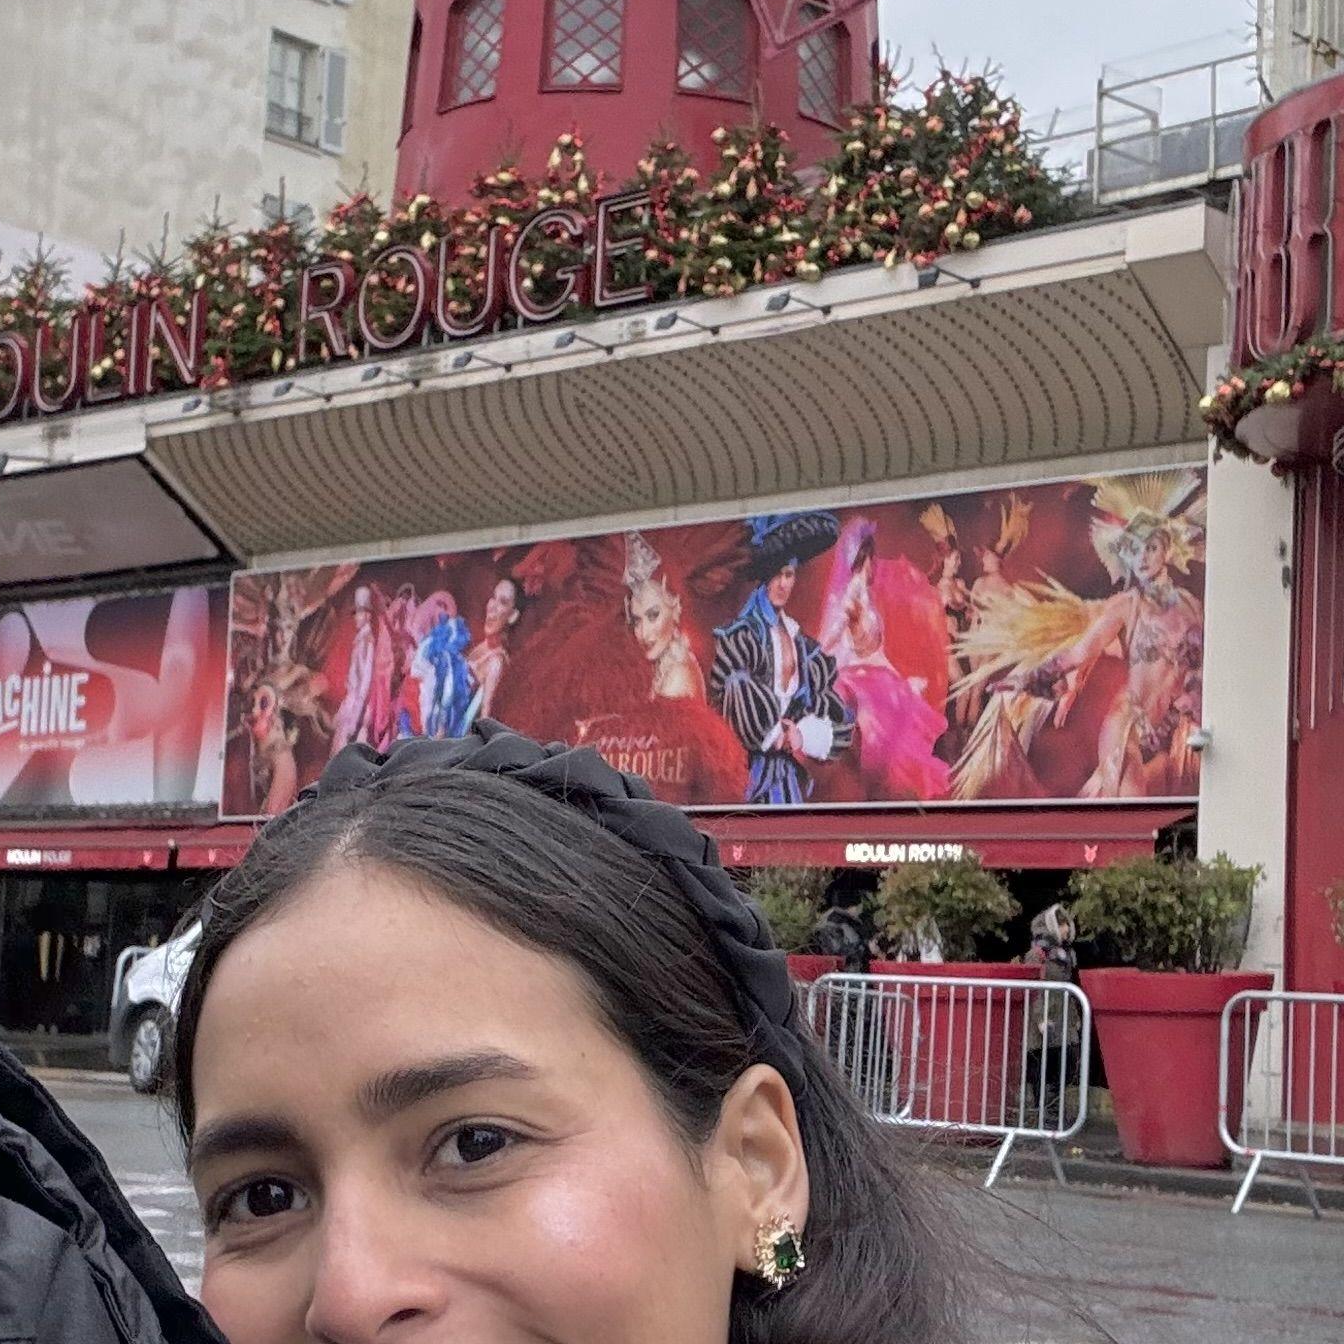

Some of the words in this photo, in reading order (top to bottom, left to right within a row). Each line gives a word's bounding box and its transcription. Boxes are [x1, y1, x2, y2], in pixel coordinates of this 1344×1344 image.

[299, 193, 653, 364] ROUGE
[617, 747, 689, 784] ROUGE
[845, 842, 905, 863] MOULIN
